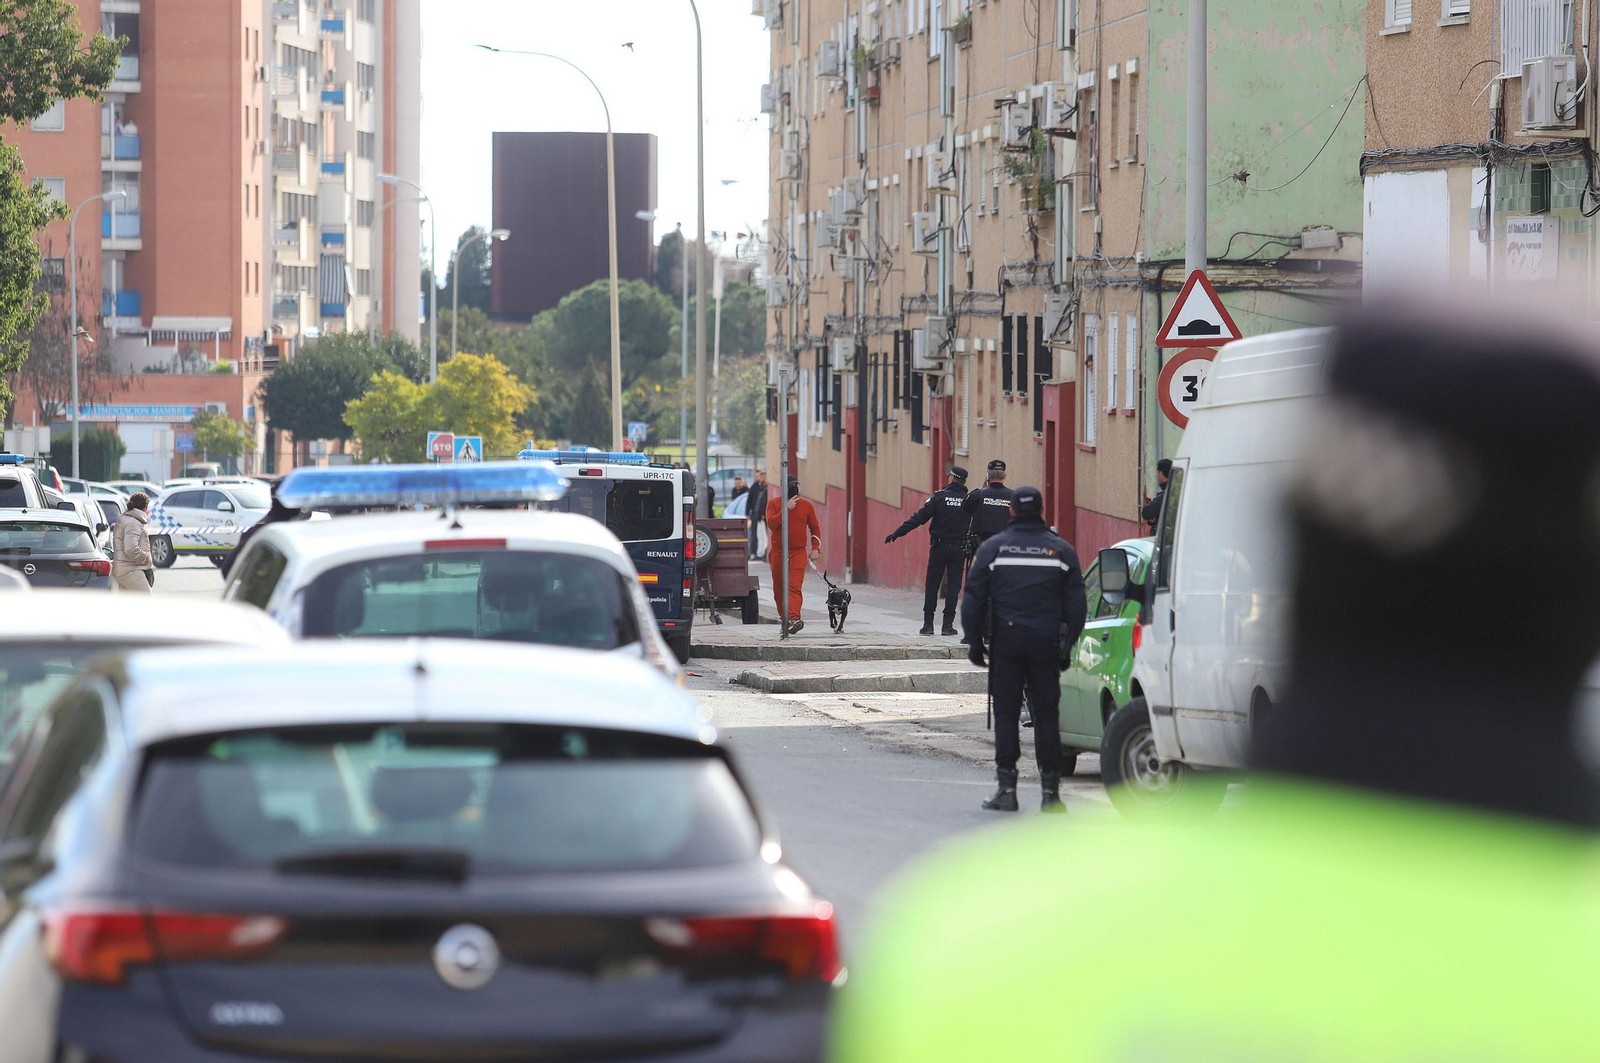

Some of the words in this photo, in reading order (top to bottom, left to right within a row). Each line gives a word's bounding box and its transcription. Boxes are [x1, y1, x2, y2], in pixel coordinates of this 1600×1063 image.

[1183, 375, 1206, 402] 3
[433, 444, 452, 452] STO
[643, 472, 675, 480] UPR-17C
[999, 545, 1048, 556] POLICIA
